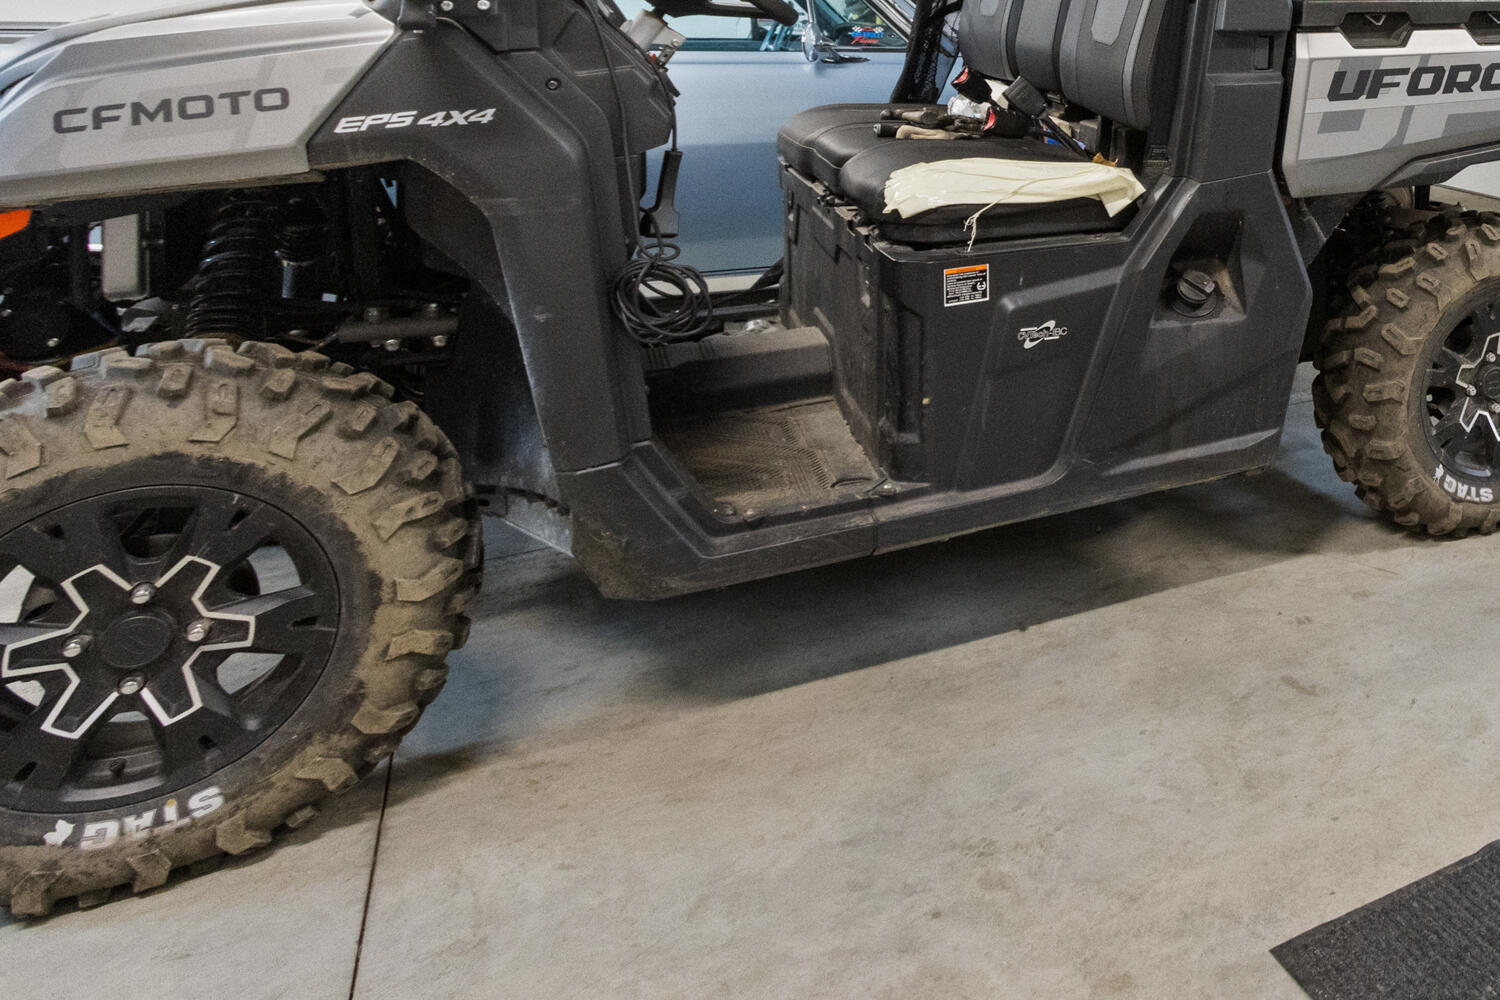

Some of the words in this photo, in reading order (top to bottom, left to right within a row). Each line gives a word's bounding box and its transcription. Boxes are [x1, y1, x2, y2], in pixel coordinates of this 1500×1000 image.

[53, 87, 290, 134] CFMOTO
[333, 110, 418, 134] EPS
[1444, 474, 1494, 502] STAG
[79, 786, 226, 850] STAG
